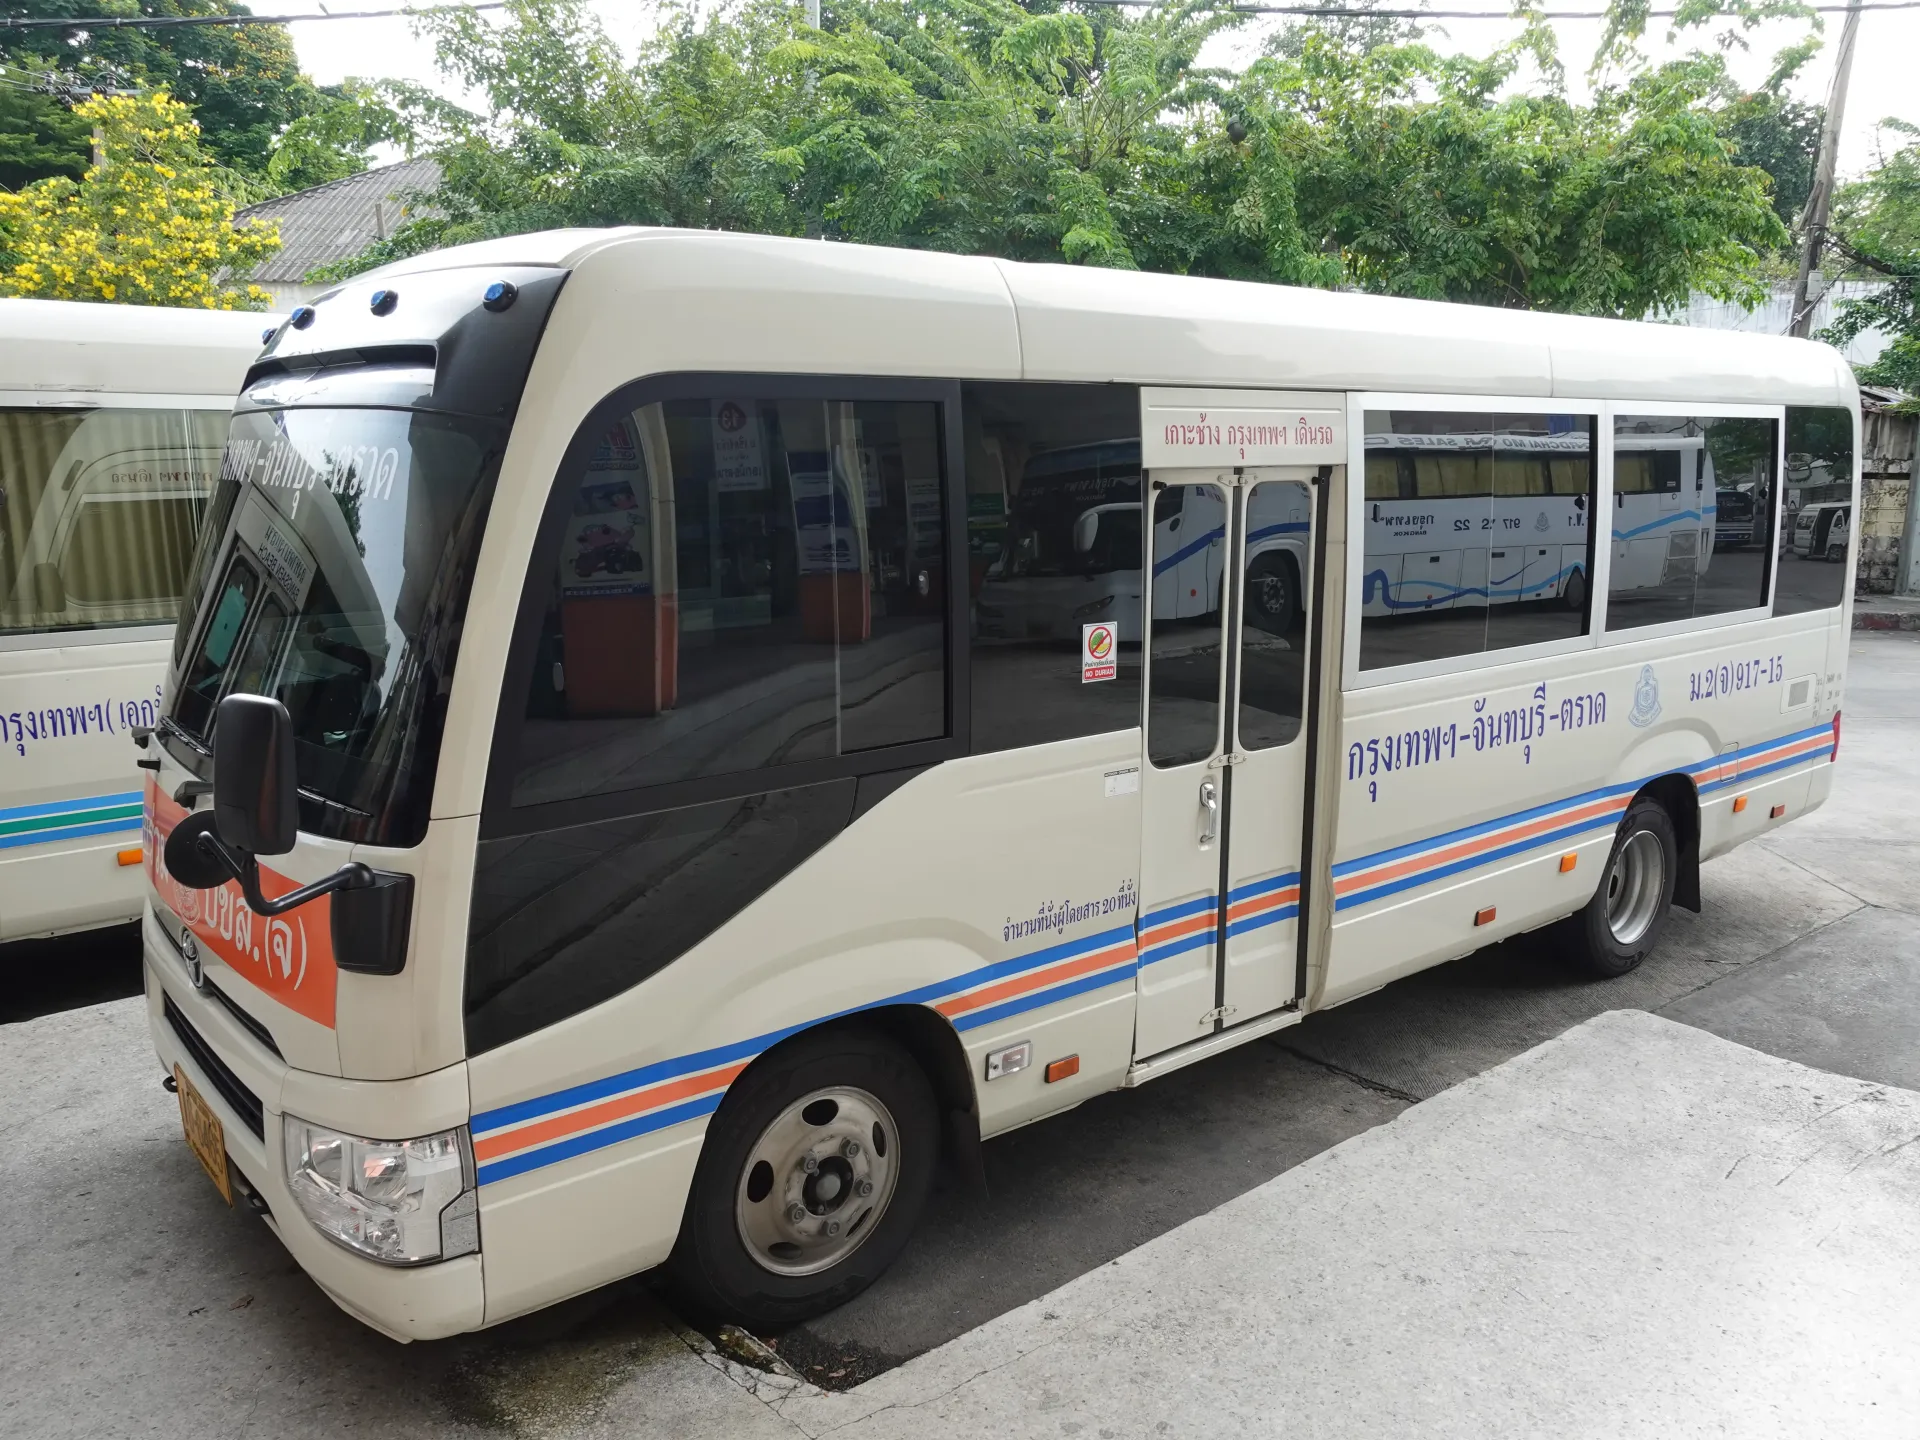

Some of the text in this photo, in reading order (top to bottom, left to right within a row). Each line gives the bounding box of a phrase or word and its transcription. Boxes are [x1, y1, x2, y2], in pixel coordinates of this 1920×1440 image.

[1165, 412, 1334, 460] เกาะช้าง กรุงเทพฯ เดินรถ
[1085, 667, 1114, 678] NO DURIAN
[1348, 681, 1607, 803] กรุงเทพฯ-จันทบุรี-ตราด
